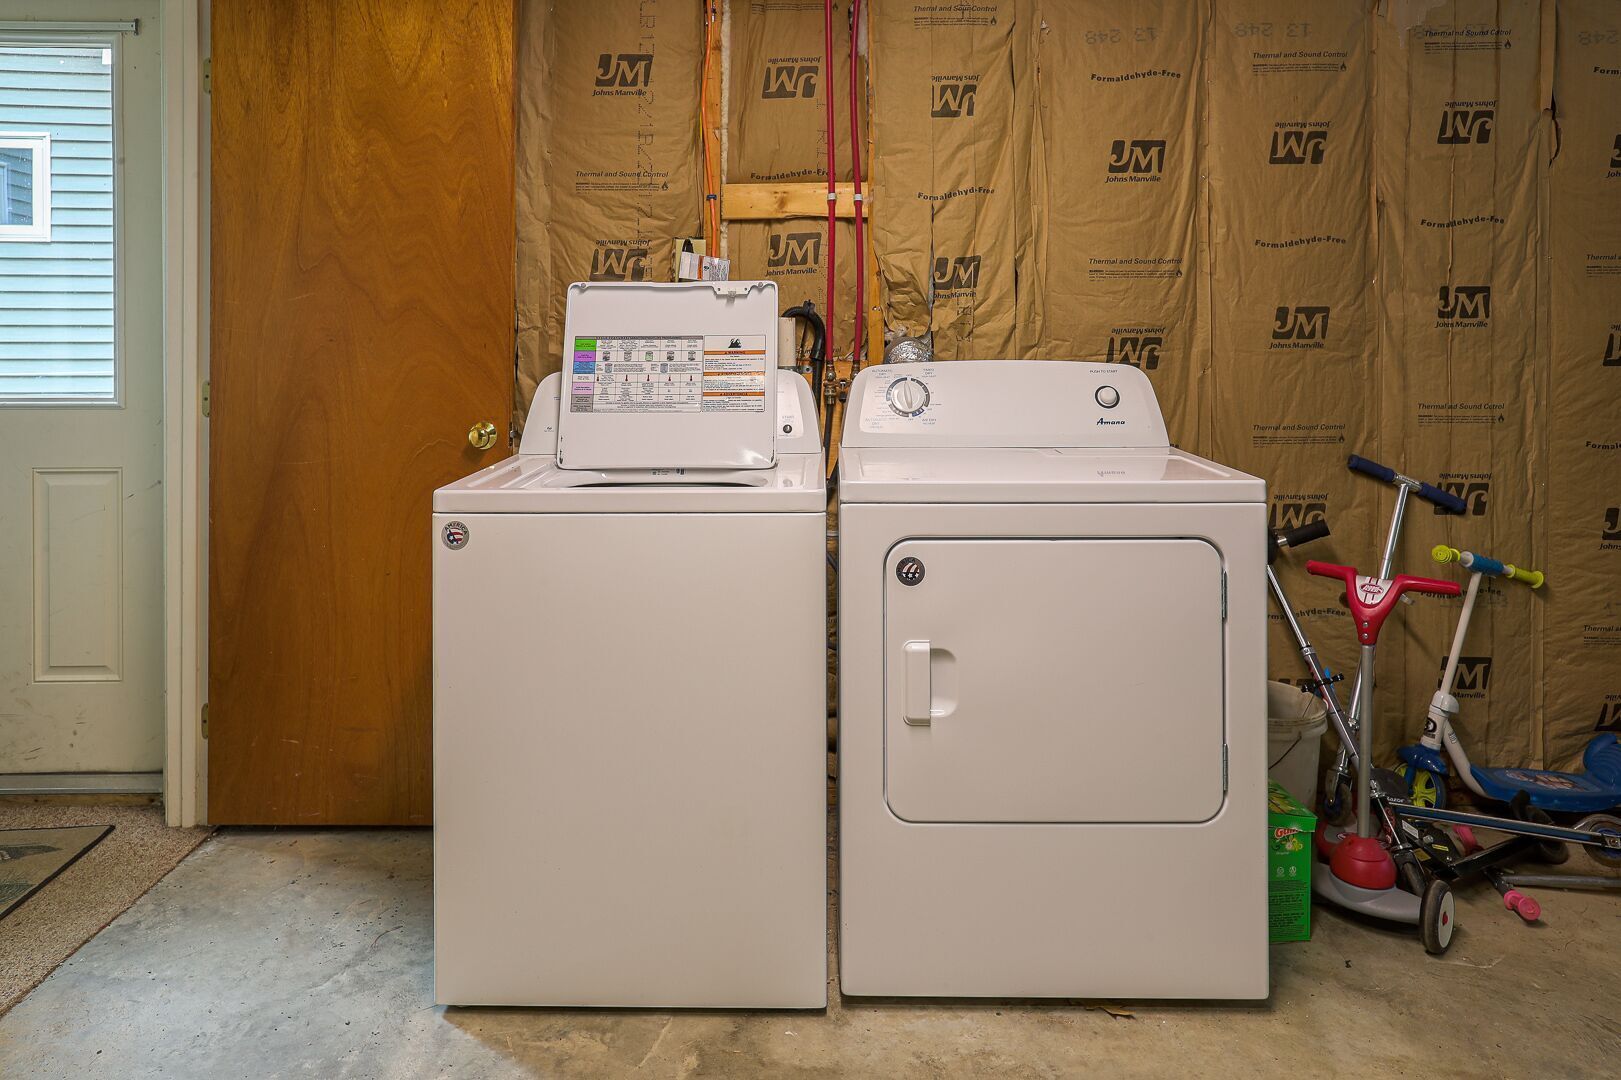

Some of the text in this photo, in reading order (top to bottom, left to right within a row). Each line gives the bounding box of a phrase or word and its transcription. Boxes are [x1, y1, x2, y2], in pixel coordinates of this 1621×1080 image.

[595, 54, 654, 87] JM
[1253, 51, 1348, 59] Thermal and Sound Control
[1593, 66, 1621, 76] Form
[762, 66, 819, 99] JM
[1091, 69, 1181, 82] Formaldehyde-Free
[931, 84, 977, 118] JM
[1275, 121, 1308, 129] Manville
[1437, 110, 1495, 144] JM
[1108, 139, 1166, 173] JM
[1269, 131, 1328, 164] JM
[768, 232, 822, 267] JM
[1255, 236, 1346, 248] Formaldehyde-Free
[590, 248, 648, 282] JM
[765, 269, 786, 277] Johns
[934, 255, 981, 290] JM
[1089, 258, 1182, 266] Thermal and Sound Control
[1438, 286, 1491, 319] JM
[1272, 306, 1330, 340] JM
[1106, 336, 1162, 370] JM
[1096, 417, 1126, 426] Amana
[1586, 441, 1621, 450] Formal
